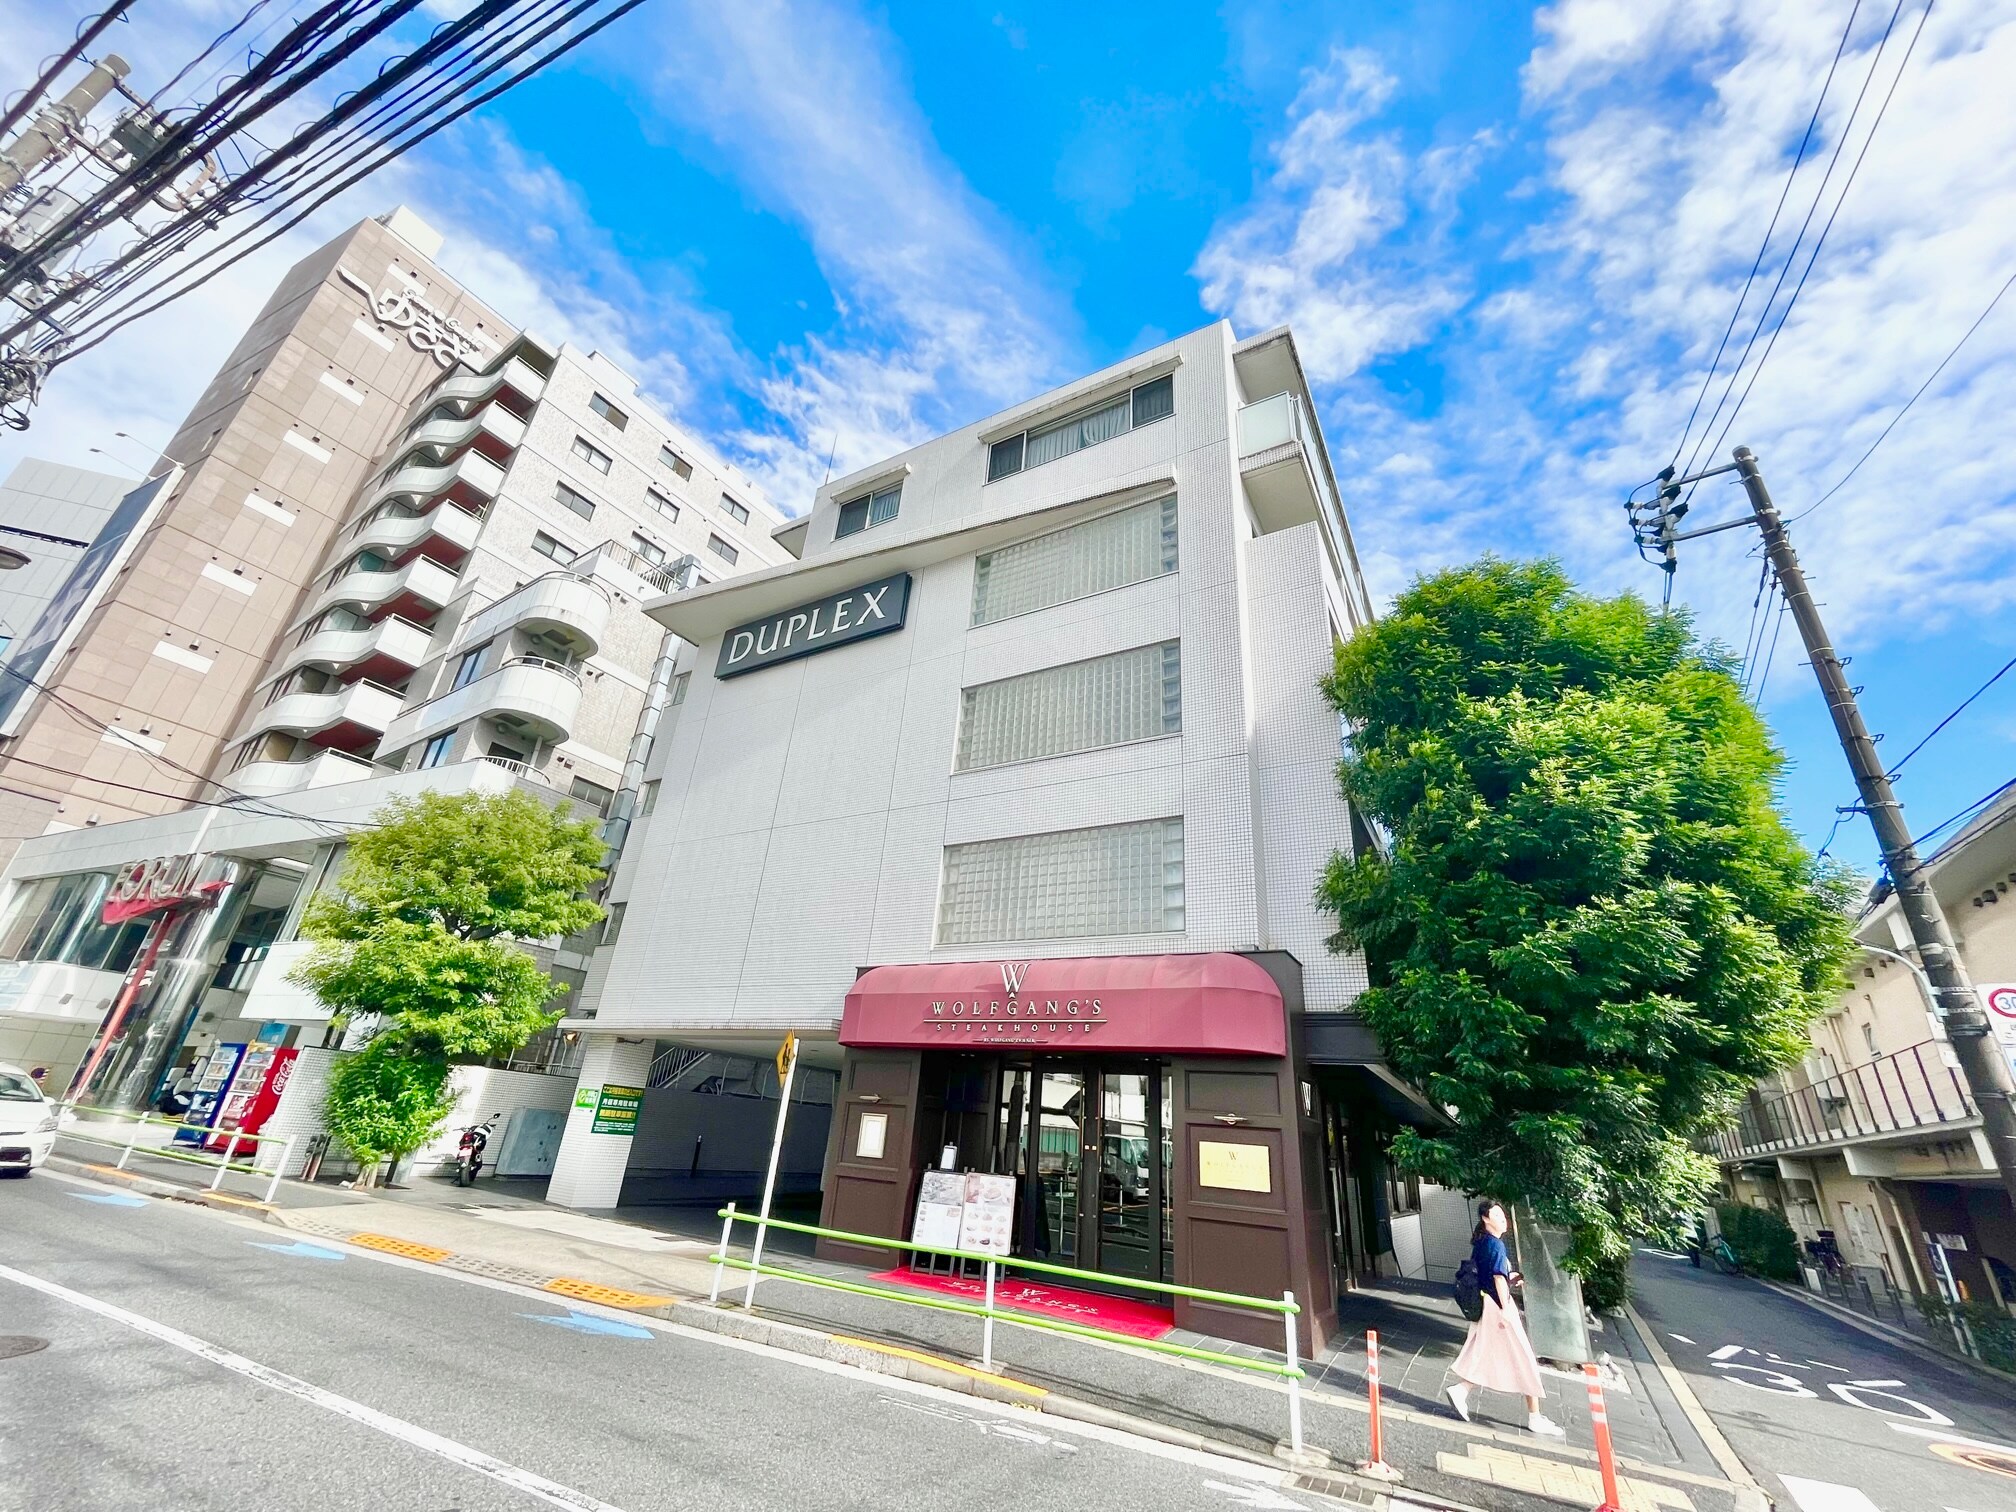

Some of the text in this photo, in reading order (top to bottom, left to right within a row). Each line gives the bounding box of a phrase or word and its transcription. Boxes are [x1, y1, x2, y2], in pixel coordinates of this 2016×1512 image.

[727, 585, 889, 665] DUPLEX
[106, 852, 216, 902] FORUM
[998, 963, 1031, 994] W
[931, 999, 1102, 1016] WOLFGANG'S
[936, 1023, 1091, 1033] STEAKHOUSE
[1710, 1361, 1956, 1427] 30
